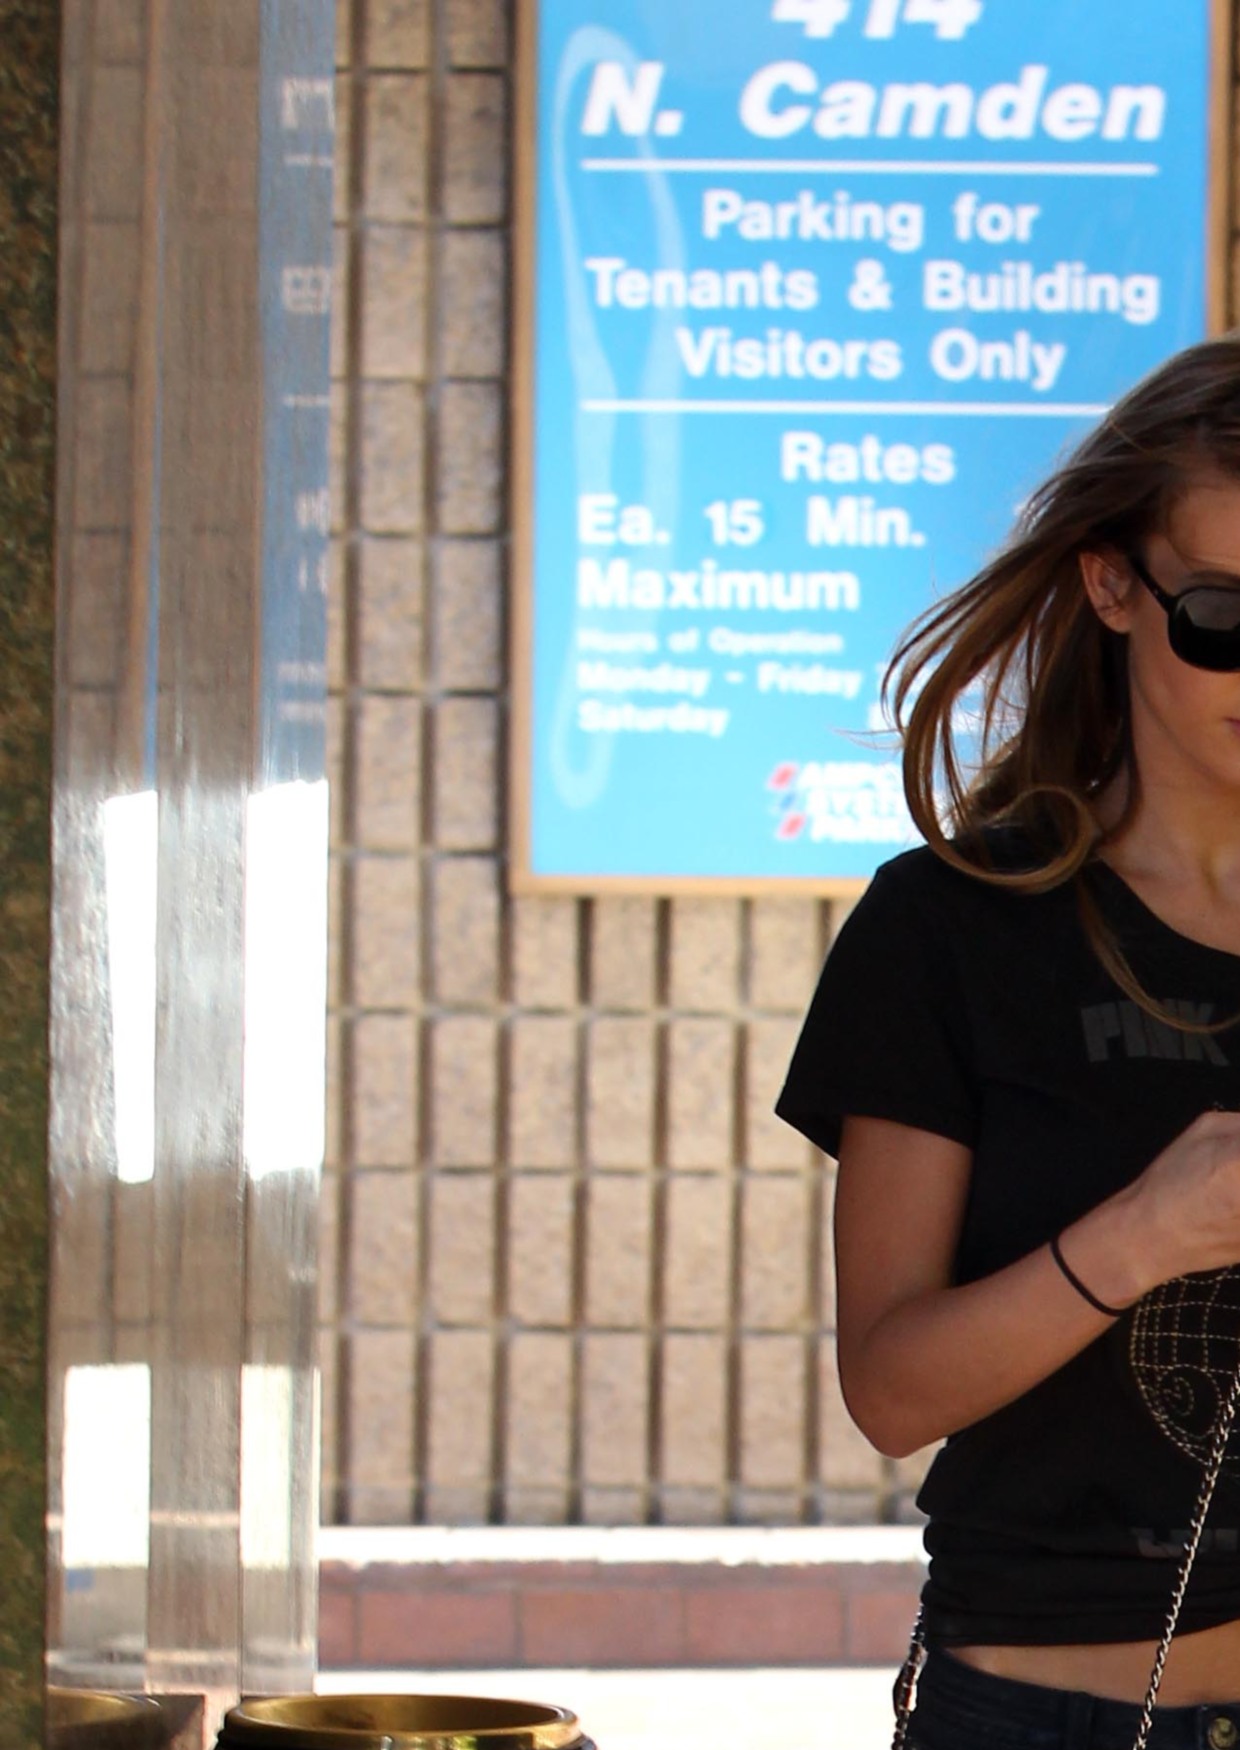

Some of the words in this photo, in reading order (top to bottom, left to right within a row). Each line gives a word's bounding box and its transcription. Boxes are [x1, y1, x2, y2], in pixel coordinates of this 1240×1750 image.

[581, 60, 682, 136] N.
[739, 61, 1166, 141] Camden
[702, 189, 923, 252] Parking
[953, 192, 1040, 243] for
[584, 257, 819, 310] Tenants
[848, 259, 891, 311] &
[923, 259, 1159, 324] Building
[675, 325, 902, 380] Visitors
[930, 328, 1066, 391] Only
[780, 430, 956, 484] Rates
[577, 493, 670, 546] Ea.
[704, 499, 763, 546] 15
[806, 495, 926, 547] Min.
[577, 555, 860, 611] Maximum
[577, 661, 710, 697] Monday
[757, 661, 862, 698] Friday
[578, 701, 729, 737] Saturday
